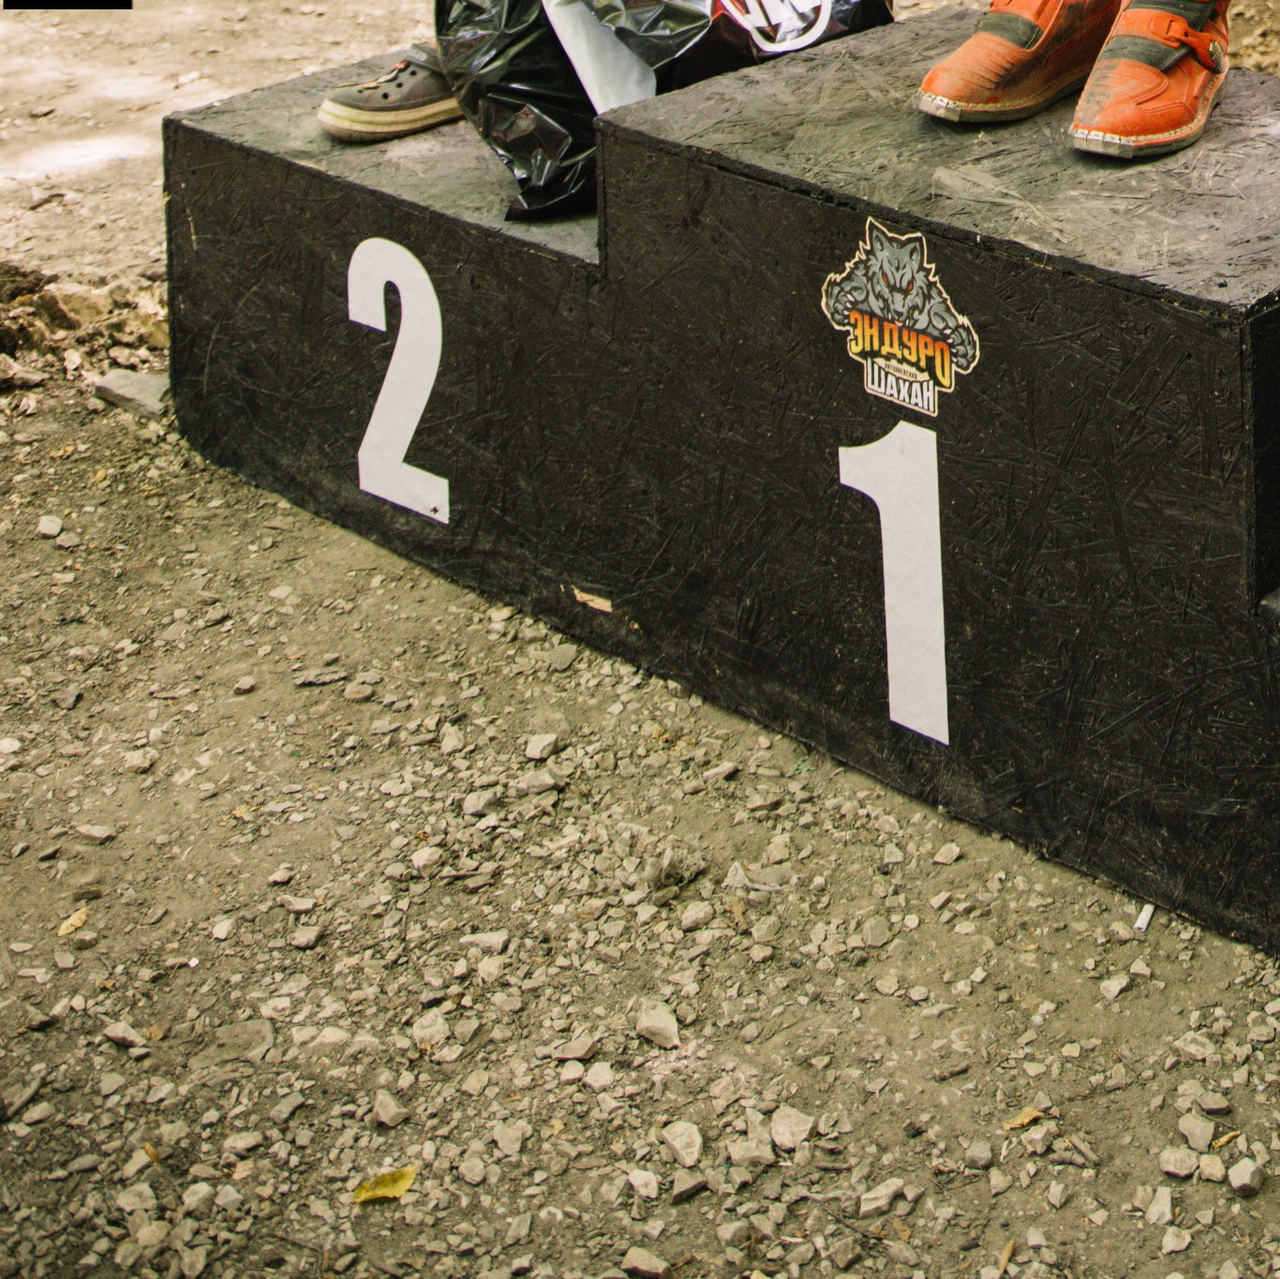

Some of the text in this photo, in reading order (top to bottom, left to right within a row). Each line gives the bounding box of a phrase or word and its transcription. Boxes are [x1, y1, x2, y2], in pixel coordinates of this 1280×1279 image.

[347, 237, 450, 524] 2
[850, 310, 951, 388] ЭНДУРО
[867, 356, 934, 413] ШАХАН
[838, 420, 949, 746] 1
